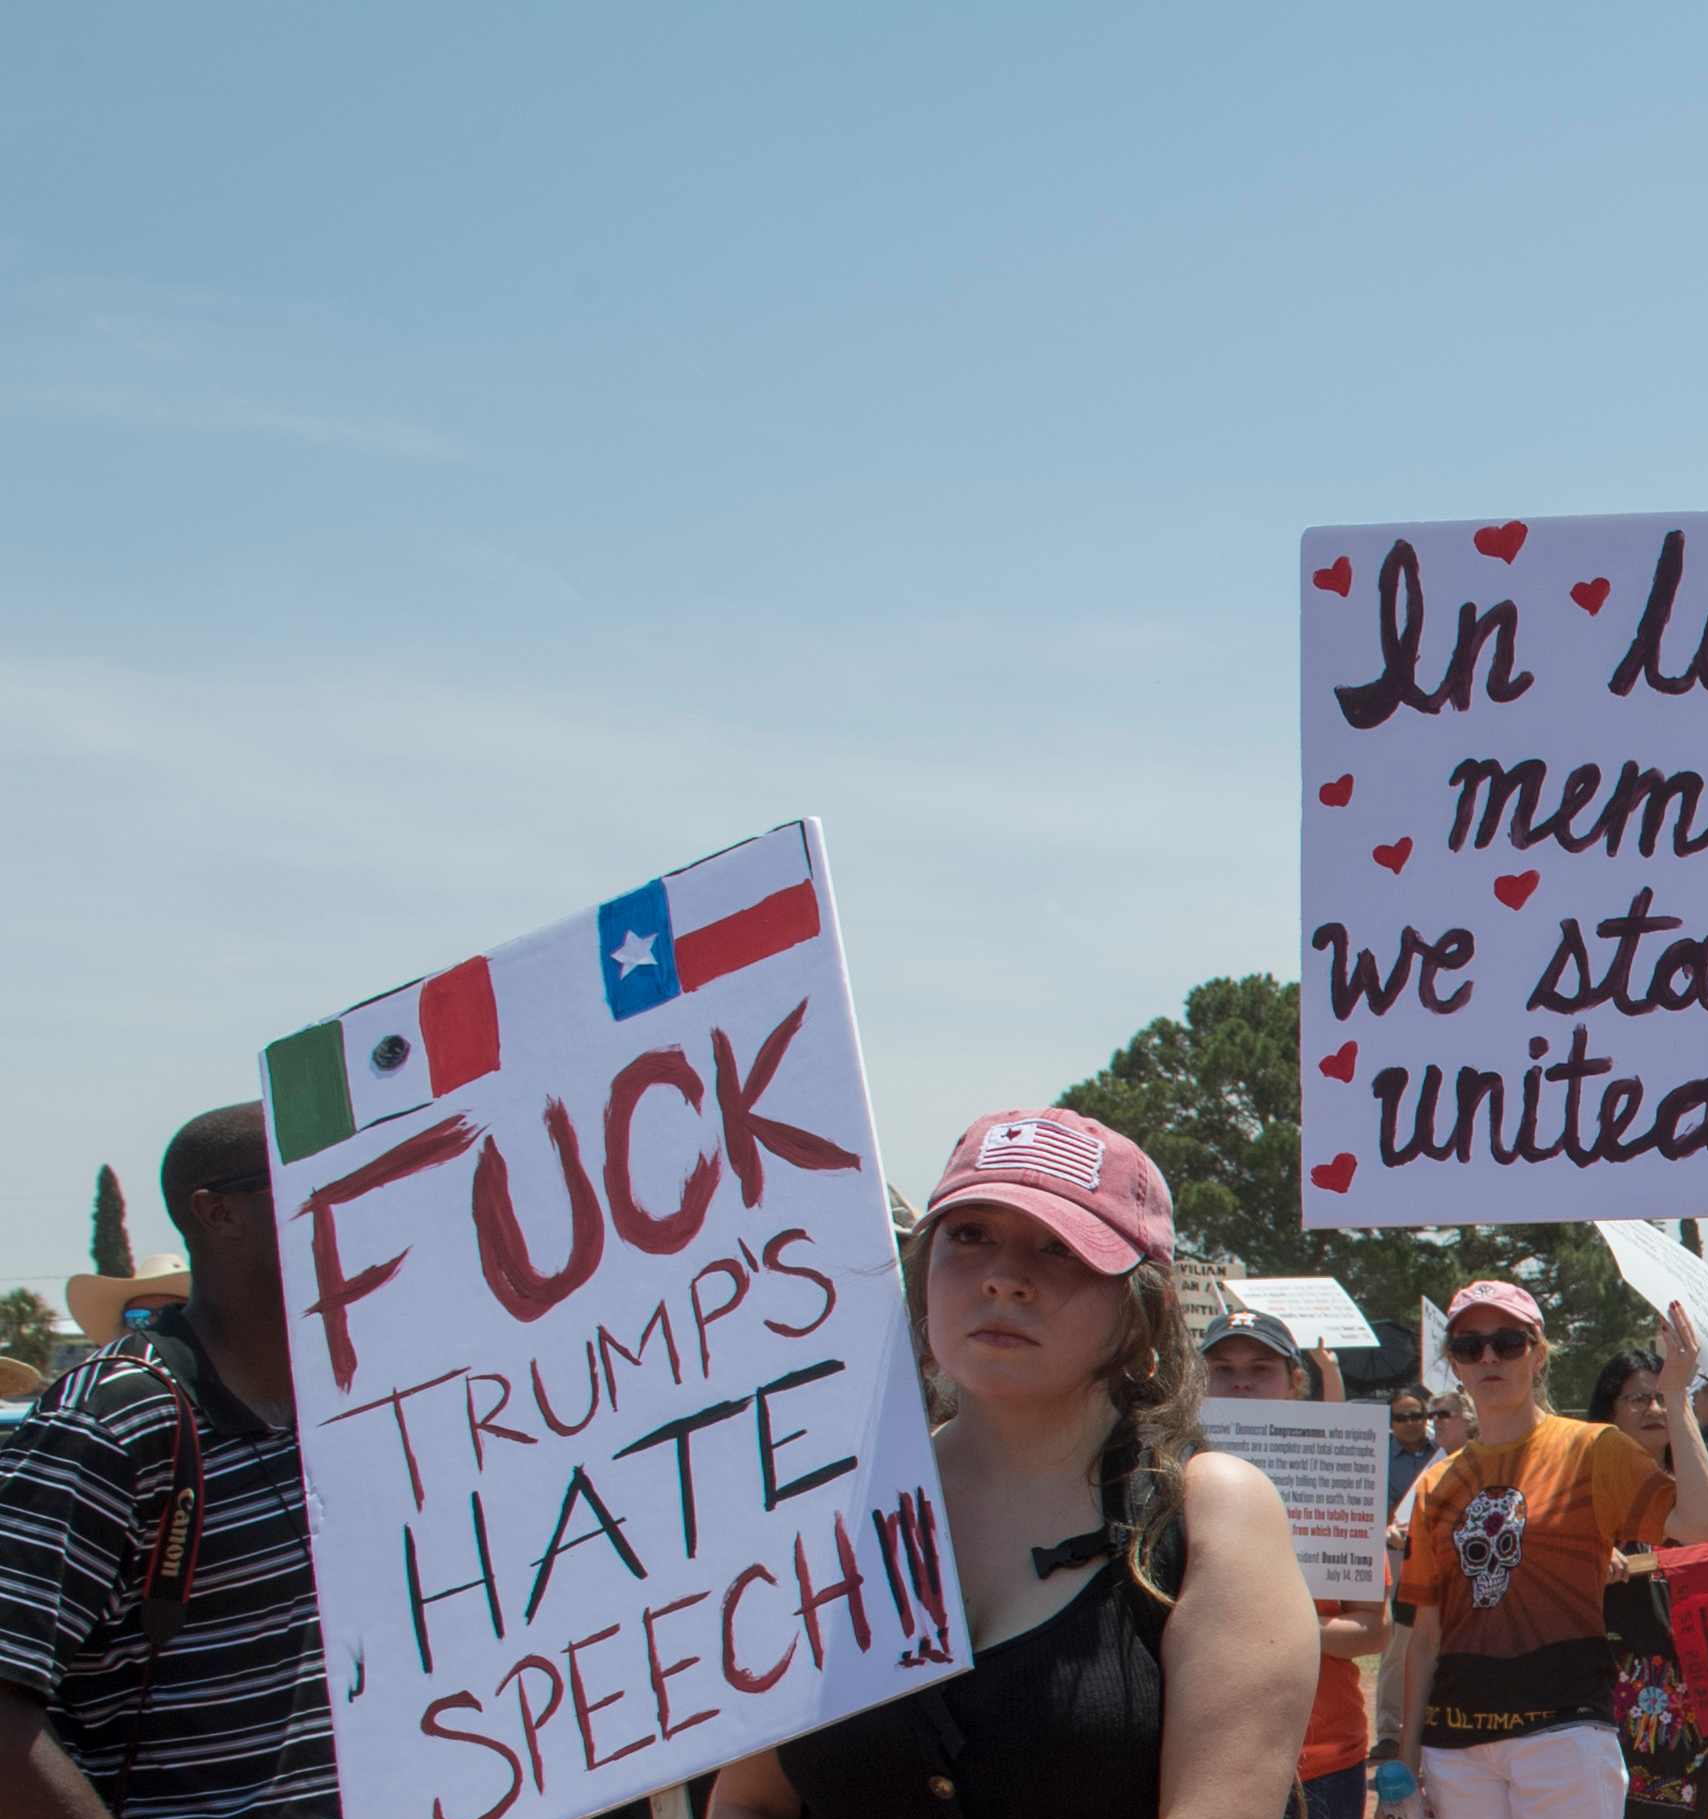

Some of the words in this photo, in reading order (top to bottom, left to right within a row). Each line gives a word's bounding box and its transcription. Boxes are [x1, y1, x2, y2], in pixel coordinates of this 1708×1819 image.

[1334, 538, 1534, 731] In
[1313, 921, 1476, 1021] we
[290, 996, 862, 1393] FUCK
[318, 1227, 836, 1511] TRUMP'S
[160, 1488, 195, 1577] Canon
[404, 1360, 858, 1674] HATE
